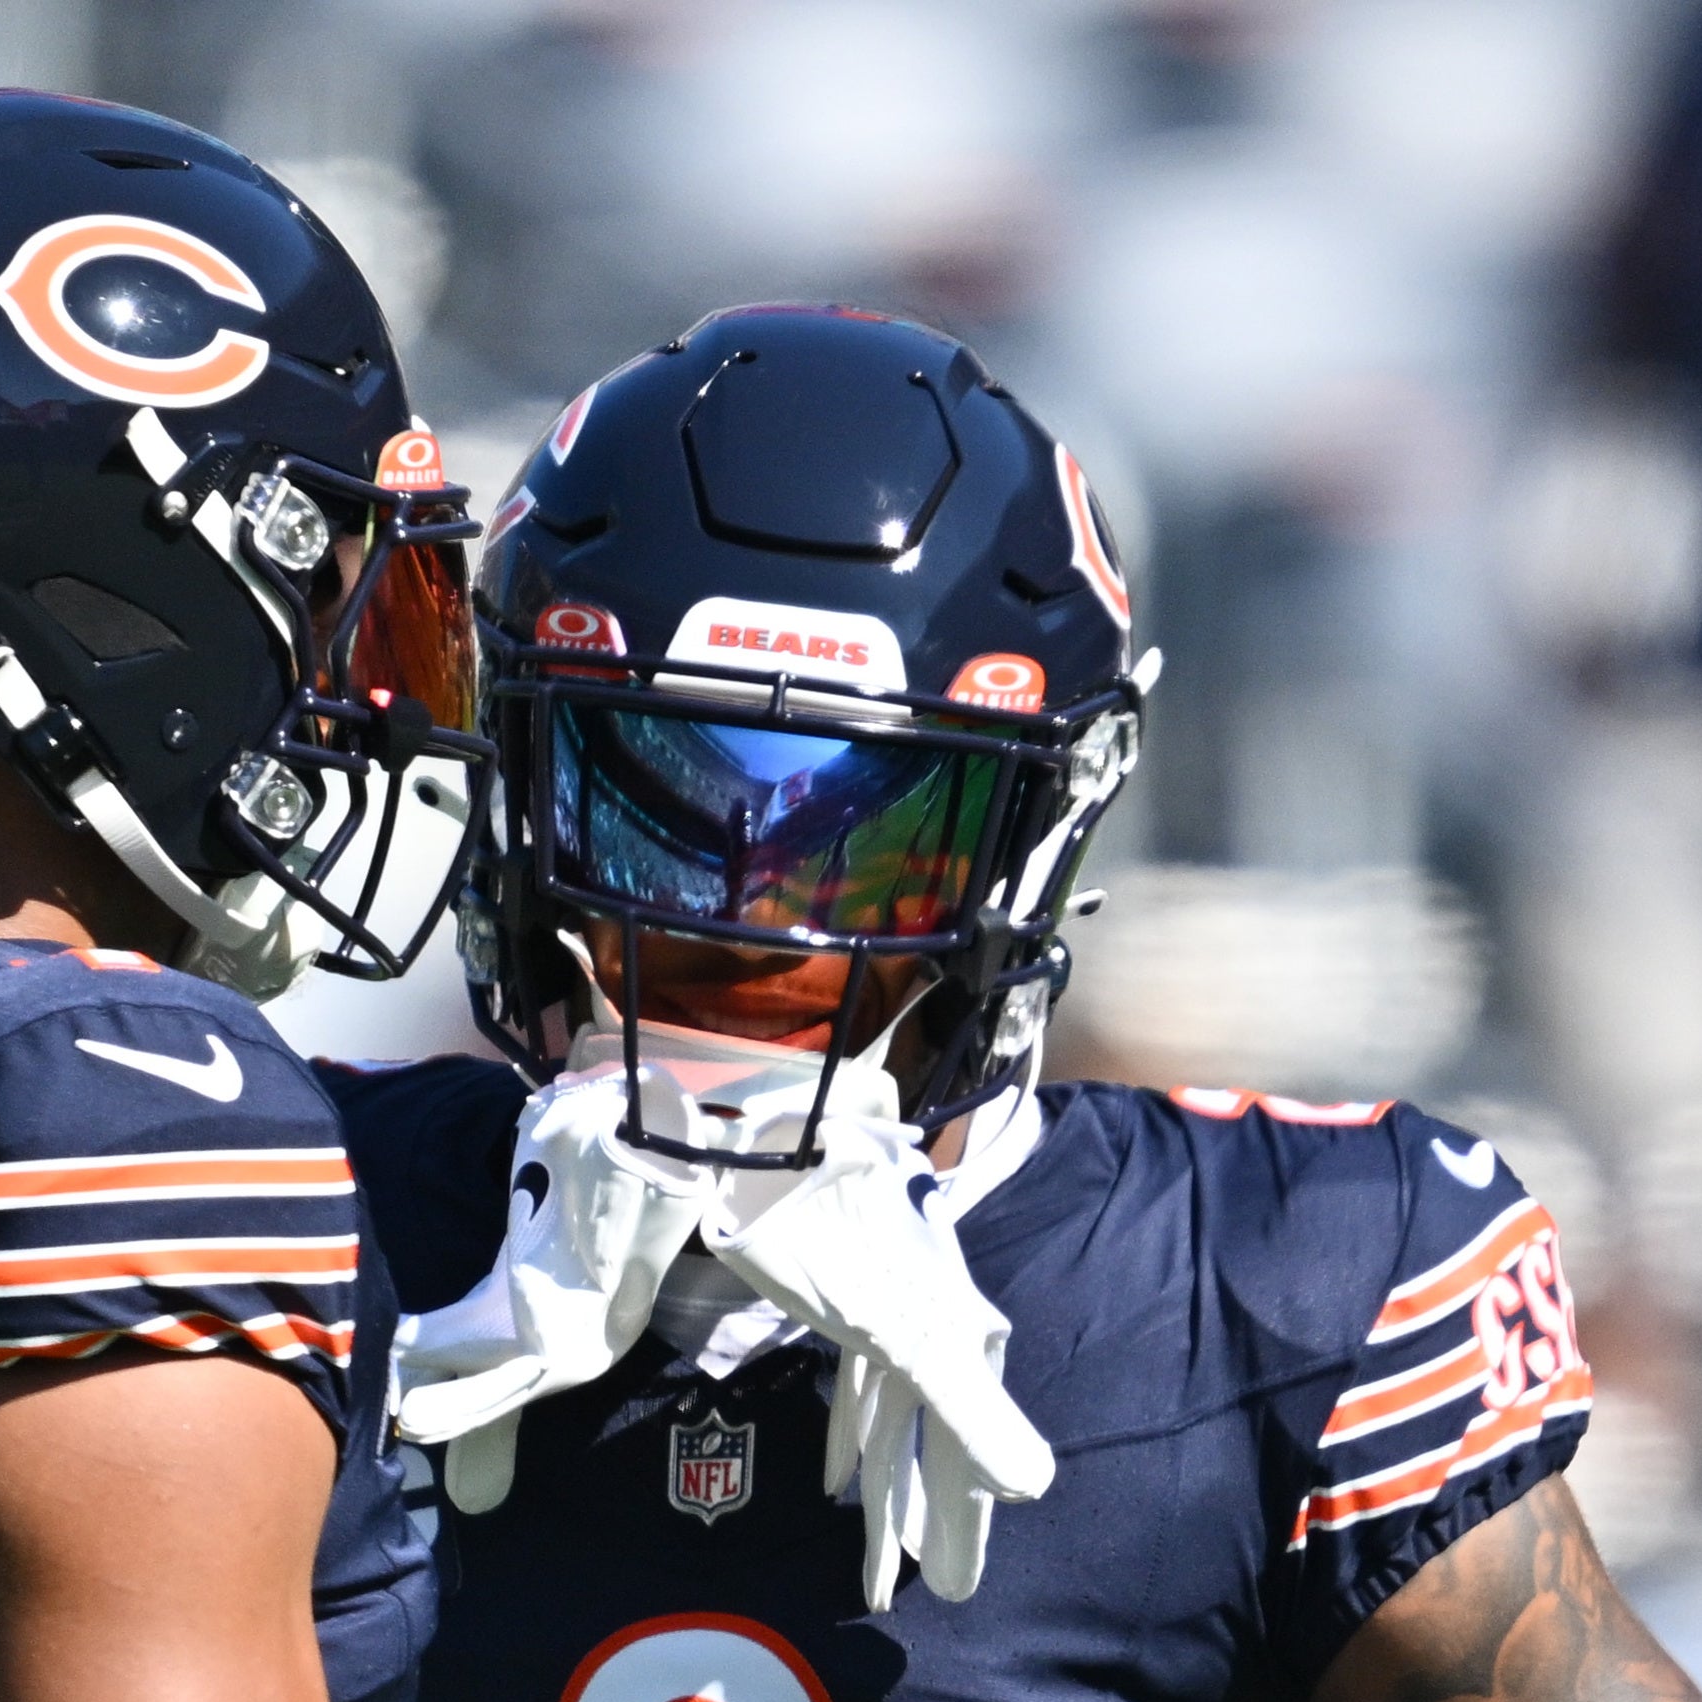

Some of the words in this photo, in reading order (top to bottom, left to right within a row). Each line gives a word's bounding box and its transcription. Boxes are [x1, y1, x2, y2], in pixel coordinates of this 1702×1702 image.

[707, 623, 869, 666] BEARS
[1471, 1233, 1585, 1412] GS
[681, 1462, 739, 1503] NFL
